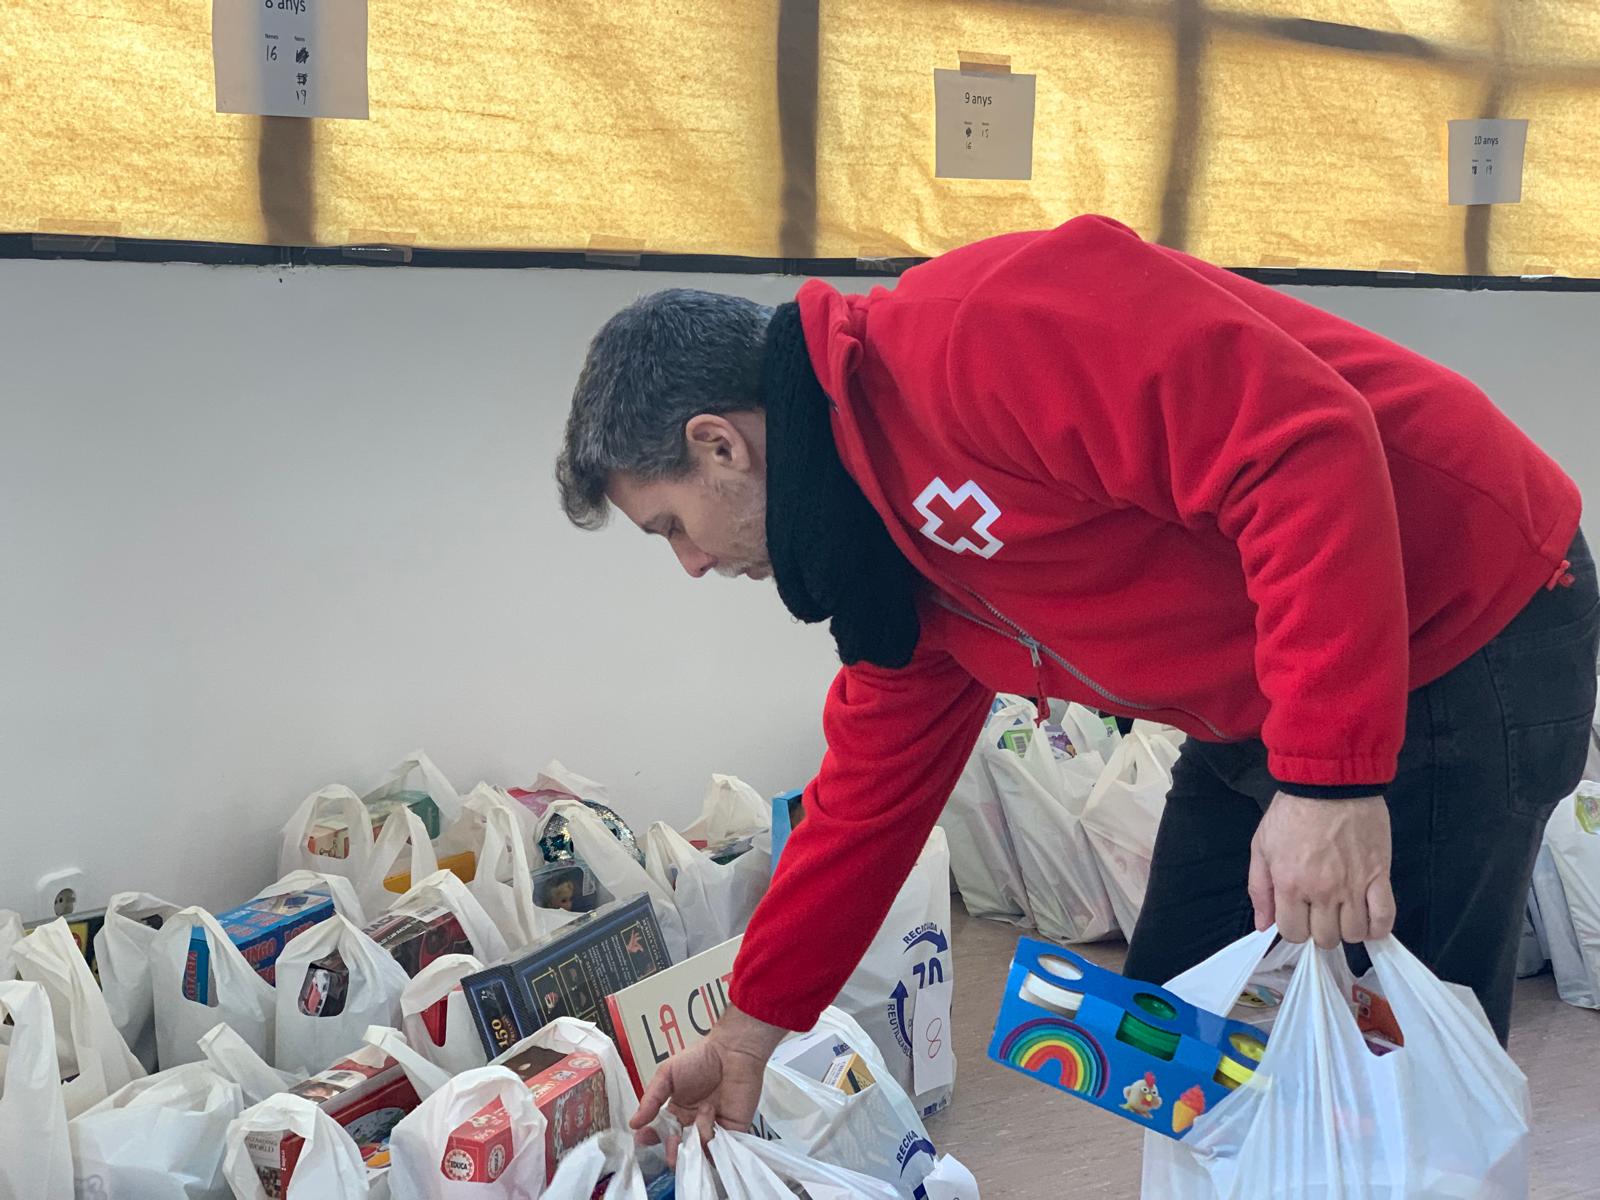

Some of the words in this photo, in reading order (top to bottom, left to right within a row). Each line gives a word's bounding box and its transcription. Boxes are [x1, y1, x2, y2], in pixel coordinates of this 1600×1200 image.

[277, 0, 306, 14] anys
[266, 45, 278, 62] 16
[964, 91, 970, 104] 9
[971, 95, 992, 107] anys
[1473, 135, 1482, 145] 10
[1482, 137, 1499, 147] anys
[641, 1004, 686, 1064] LA
[688, 972, 733, 1036] CIU
[926, 1017, 943, 1059] 8
[450, 1159, 468, 1171] EDUCA
